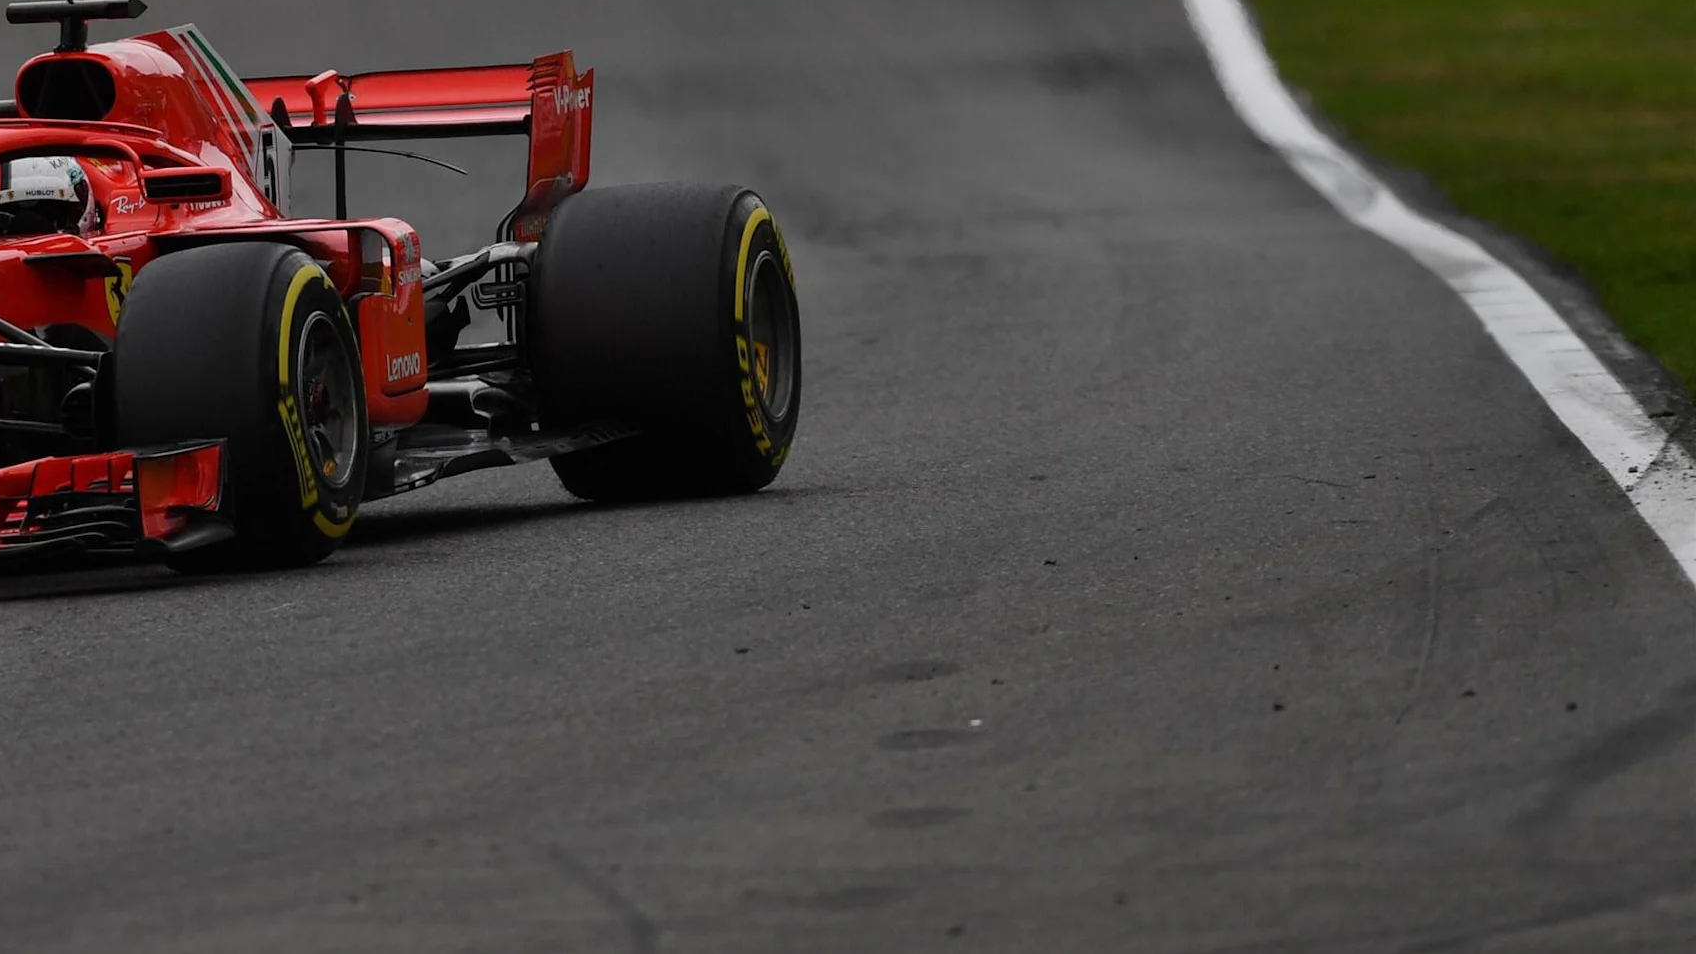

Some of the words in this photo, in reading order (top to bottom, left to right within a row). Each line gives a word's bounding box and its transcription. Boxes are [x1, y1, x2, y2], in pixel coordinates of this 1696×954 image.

[553, 85, 591, 115] V-Power
[25, 189, 55, 197] HUBLOT
[111, 194, 147, 214] Ray-B
[386, 352, 421, 382] Lenovo
